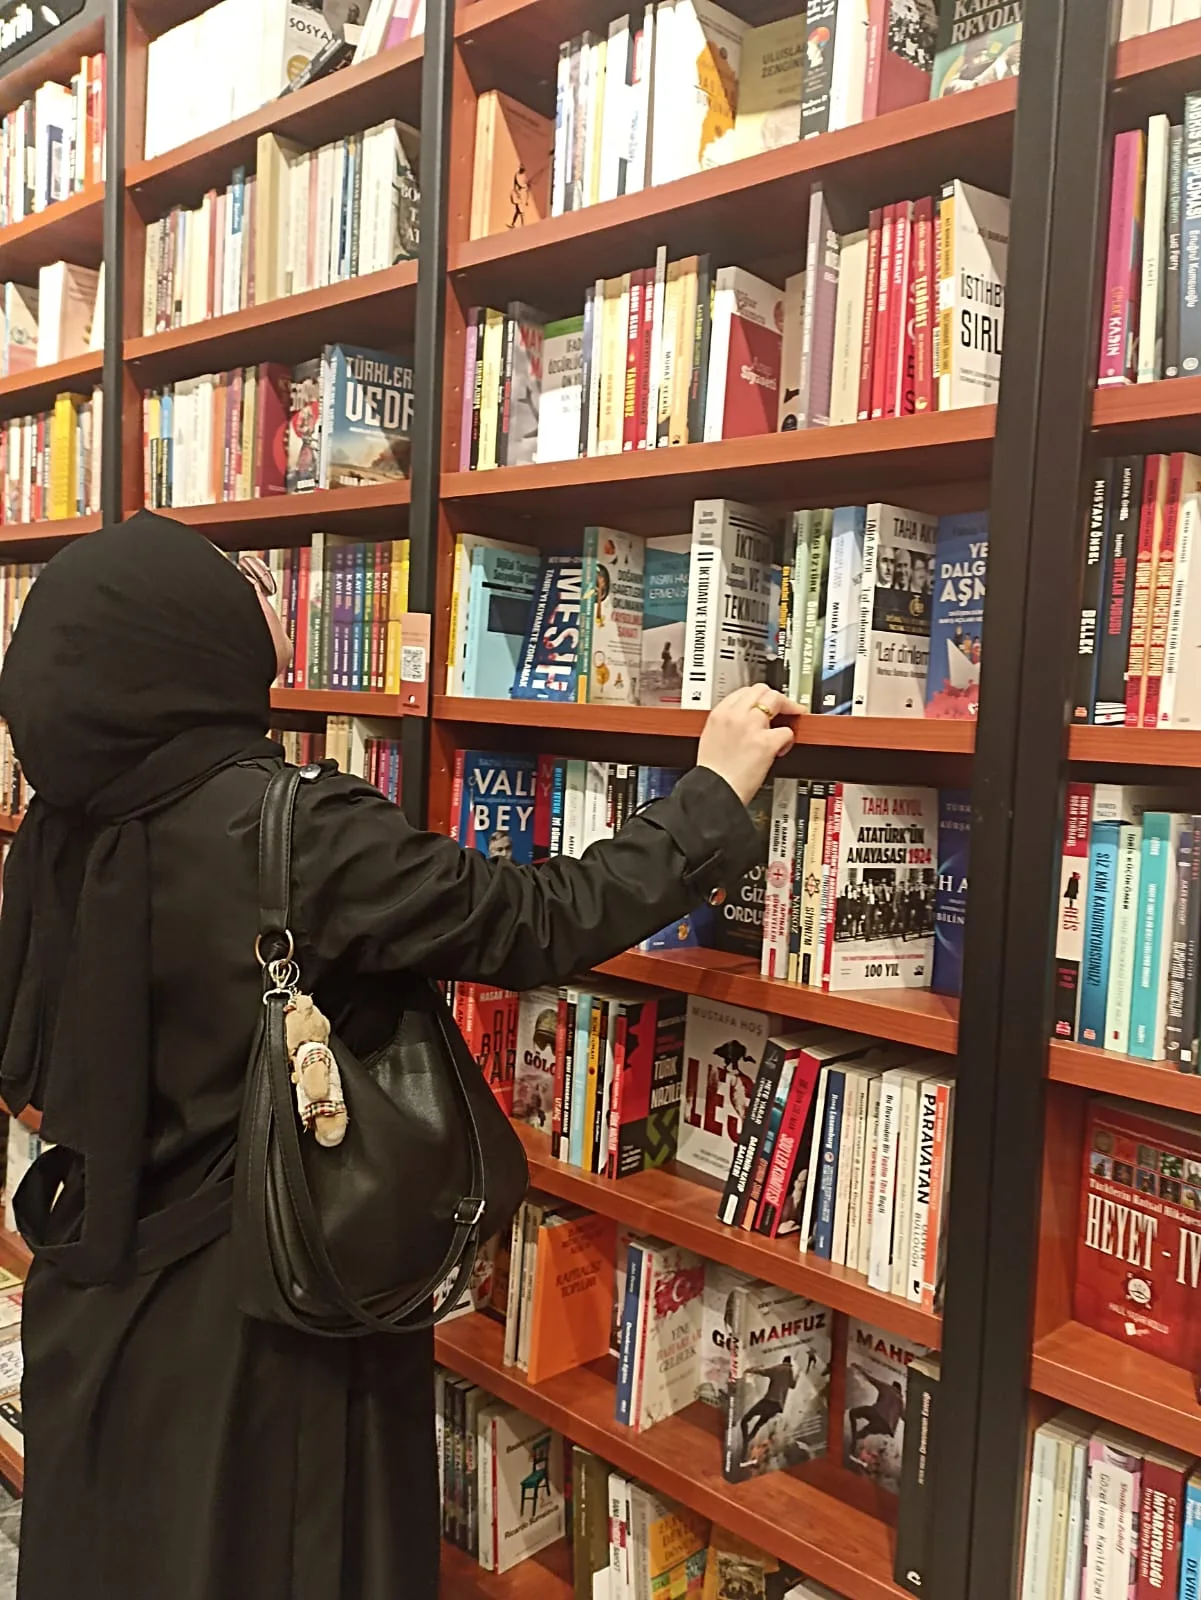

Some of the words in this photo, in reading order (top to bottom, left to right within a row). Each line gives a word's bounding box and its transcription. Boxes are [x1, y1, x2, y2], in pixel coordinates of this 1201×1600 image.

[951, 2, 1022, 45] REVOLV
[960, 267, 1002, 308] İSTİHB
[960, 309, 1003, 354] SIRL
[969, 542, 988, 558] YE
[941, 561, 986, 579] DALG
[345, 574, 353, 595] KAYI
[697, 566, 710, 604] İKTİDAR
[697, 605, 708, 617] VE
[693, 619, 707, 668] TEKNOLOJİ
[1078, 610, 1097, 655] BELLEK
[896, 641, 930, 665] dinlem
[473, 769, 536, 796] VALİ
[473, 805, 534, 831] BEY
[861, 797, 889, 815] TAHA
[891, 797, 923, 816] AKYOL
[856, 823, 925, 844] ATATÜRK'ÜN
[847, 847, 906, 863] ANAYASASI
[907, 848, 931, 864] 1924
[1095, 852, 1110, 869] SİZ
[741, 884, 765, 903] GİZ
[939, 874, 968, 892] HA
[1093, 871, 1109, 893] KİMİ
[723, 904, 763, 925] ORDU
[791, 895, 800, 934] NARKOZ
[936, 912, 965, 925] BİLİN
[865, 963, 882, 977] 100
[885, 963, 900, 977] YIL
[917, 1093, 936, 1205] PARAVATAN
[1084, 1194, 1158, 1271] HEYET
[749, 1313, 826, 1347] MAHFUZ
[856, 1329, 914, 1366] MAHF
[1097, 1474, 1110, 1529] Gözetleme
[1166, 1497, 1177, 1550] Çevrenin
[1149, 1491, 1167, 1588] İMPARATORLUĞU
[1092, 1535, 1107, 1600] Kapitalizm
